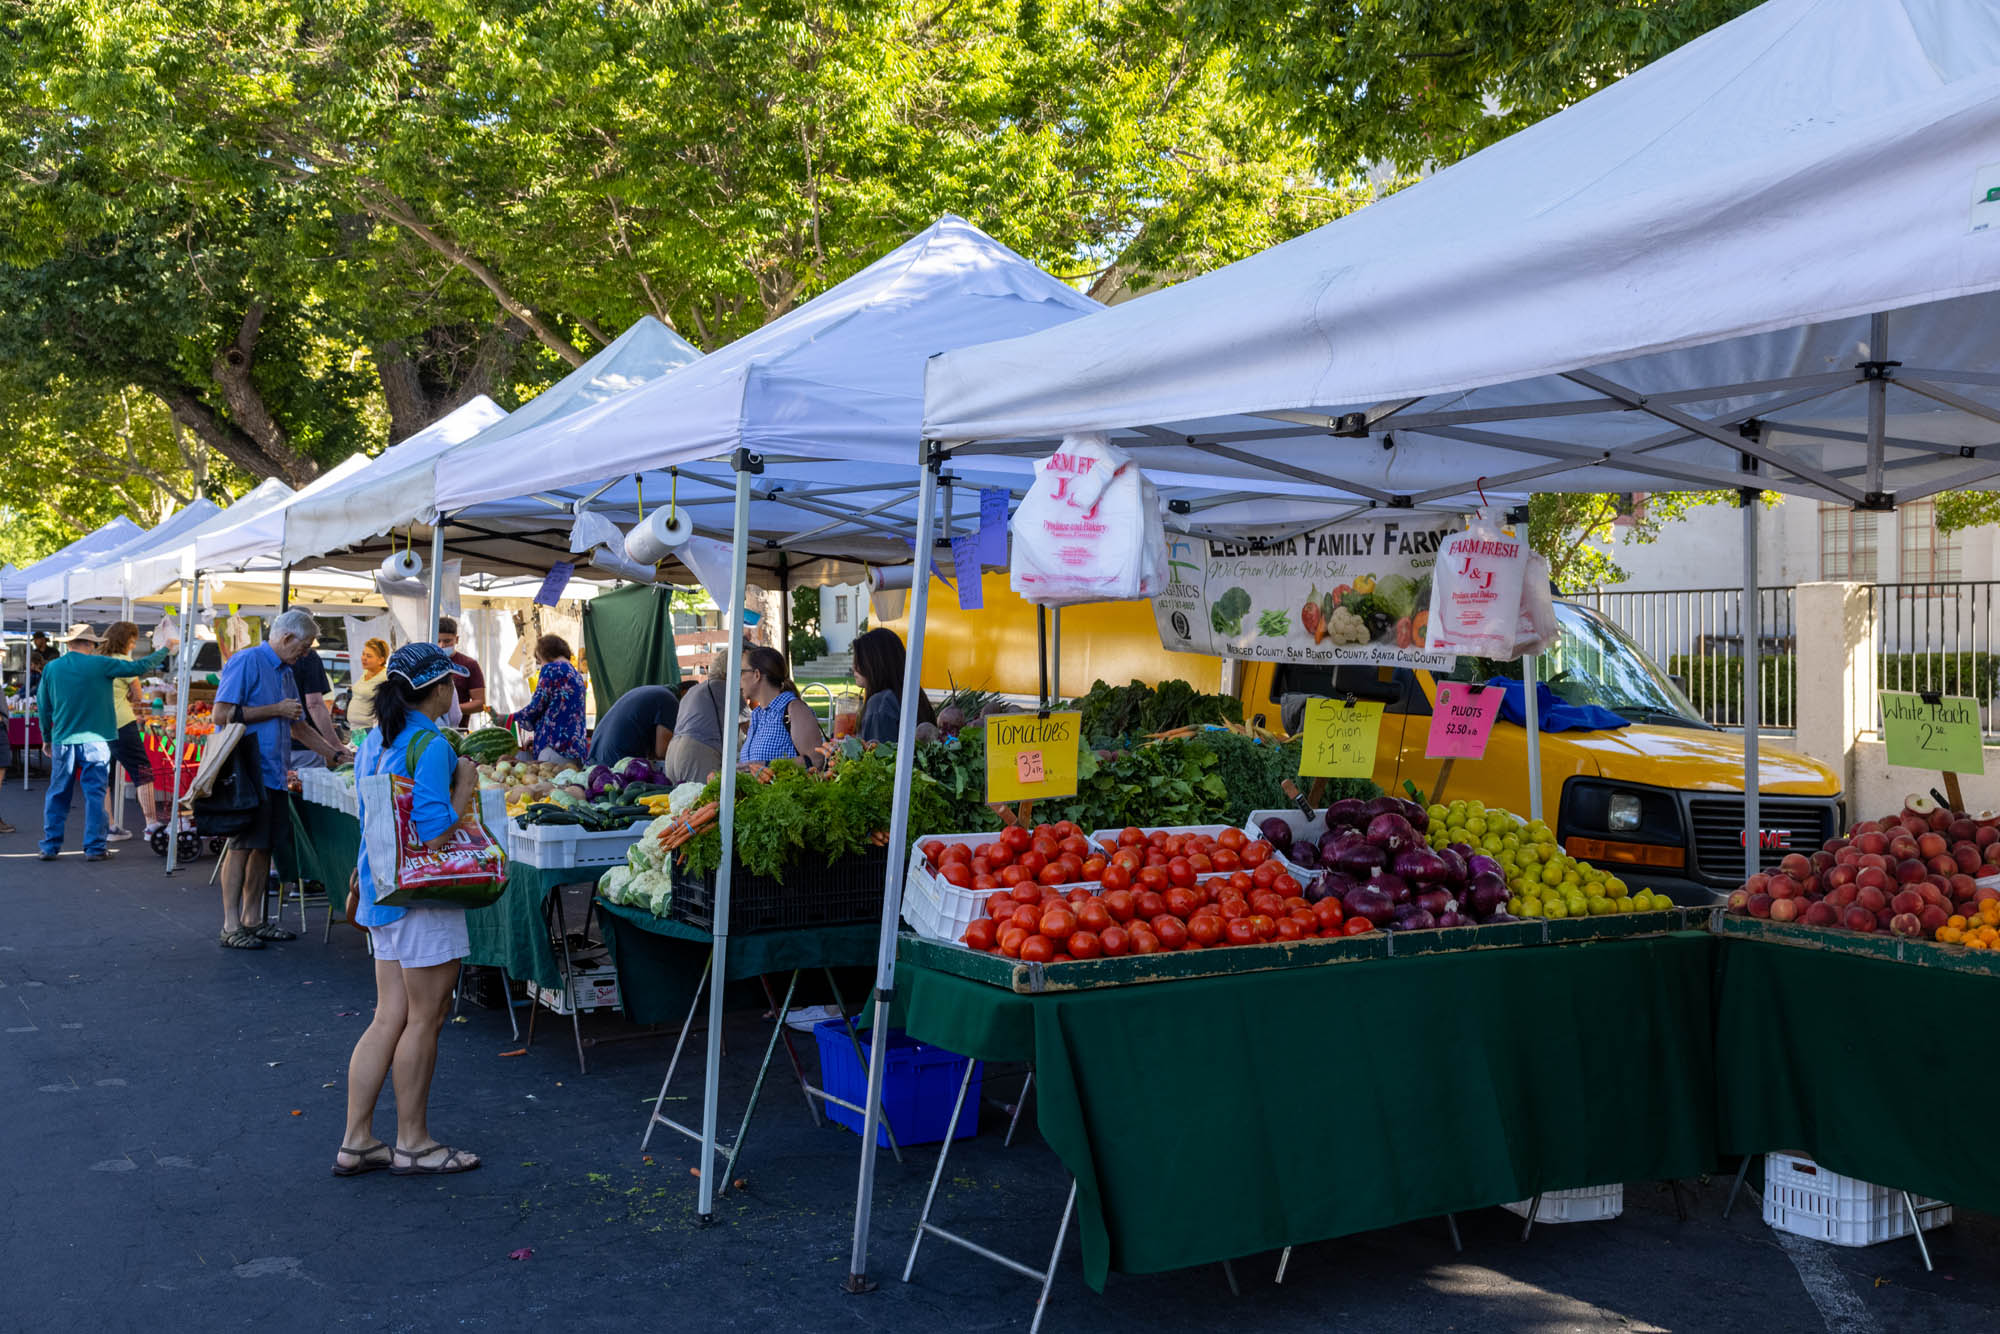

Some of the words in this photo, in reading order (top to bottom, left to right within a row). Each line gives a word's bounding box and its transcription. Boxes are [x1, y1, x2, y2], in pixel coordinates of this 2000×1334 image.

[1050, 477, 1070, 500] J
[1305, 530, 1375, 556] FAMILY
[1448, 539, 1480, 555] FARM
[1480, 541, 1520, 558] FRESH
[1266, 560, 1298, 579] What
[1300, 560, 1322, 578] We
[1458, 557, 1472, 575] J
[1469, 567, 1481, 579] &
[1480, 571, 1495, 589] J
[1287, 647, 1304, 658] SAN
[1305, 647, 1333, 660] BENITO
[1334, 648, 1369, 660] COUNTY,
[1370, 648, 1395, 661] SANTA
[1413, 650, 1447, 665] COUNTY
[1315, 699, 1373, 723] Sweet
[1451, 705, 1484, 718] PLUOTS
[1882, 695, 1925, 721] White
[989, 719, 1070, 746] Tomatoes
[1326, 722, 1361, 739] Onion
[1445, 723, 1468, 735] $2.50
[405, 855, 440, 872] BELL
